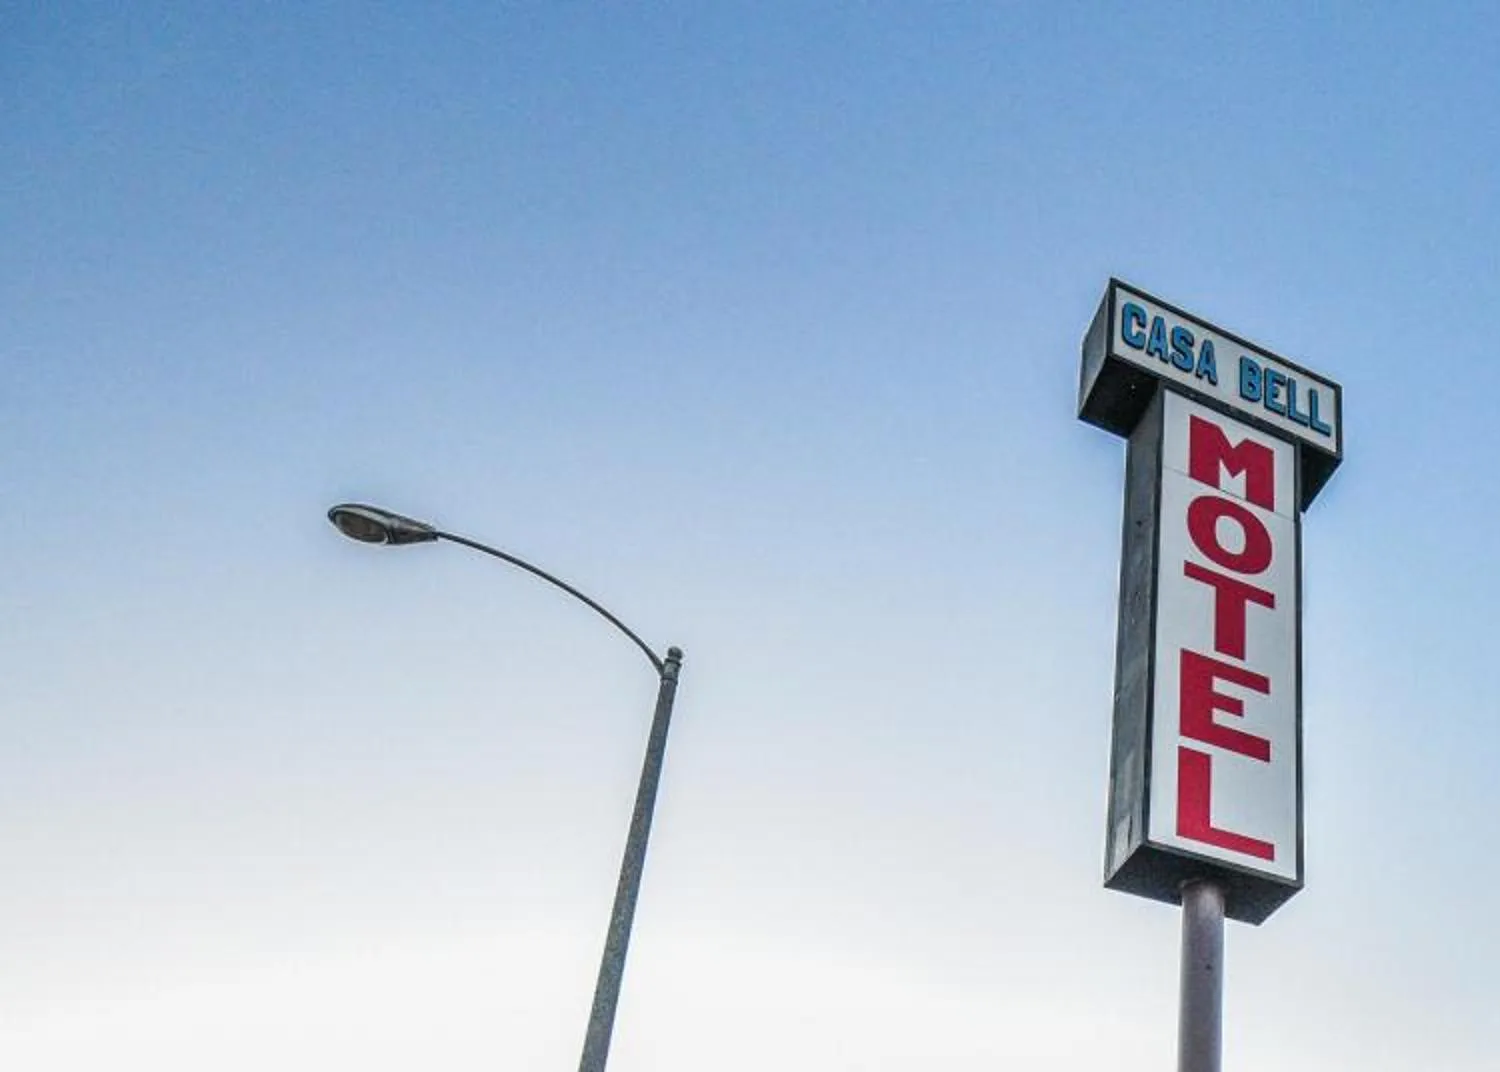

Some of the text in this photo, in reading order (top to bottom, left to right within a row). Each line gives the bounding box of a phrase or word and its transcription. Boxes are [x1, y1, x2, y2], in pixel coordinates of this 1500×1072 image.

[1121, 302, 1331, 438] CASA BELL
[1176, 414, 1275, 862] MOTEL
